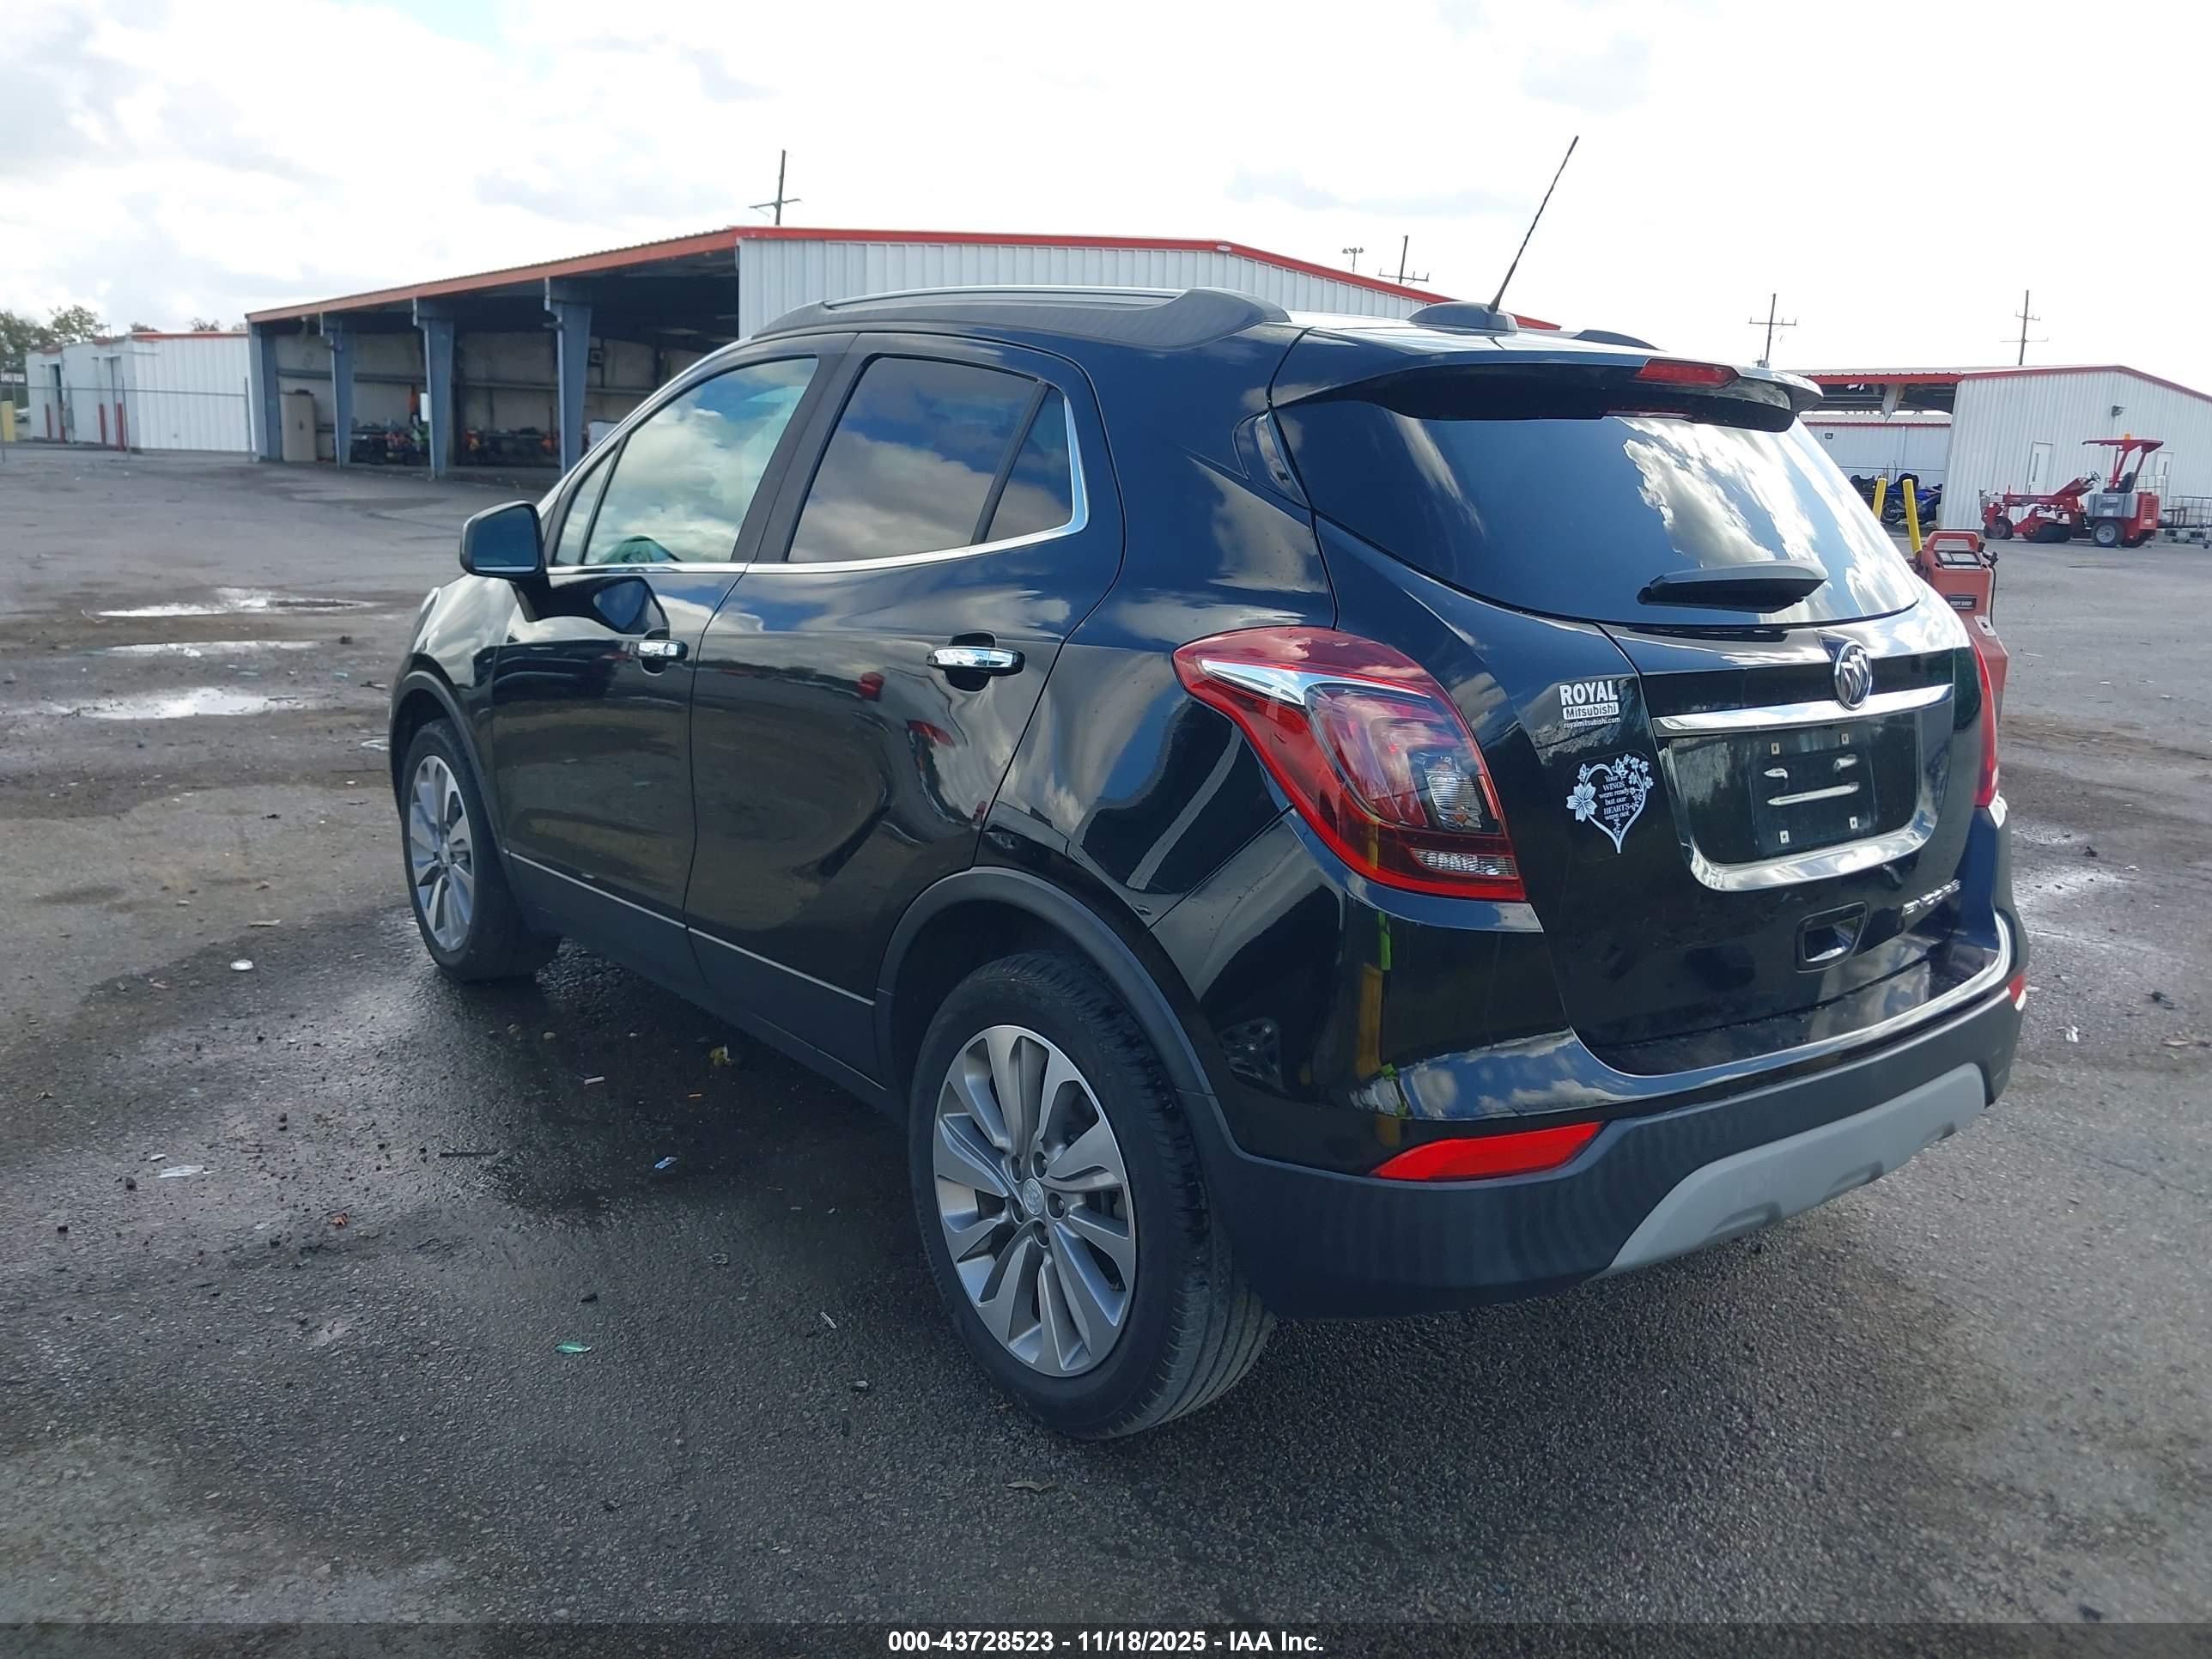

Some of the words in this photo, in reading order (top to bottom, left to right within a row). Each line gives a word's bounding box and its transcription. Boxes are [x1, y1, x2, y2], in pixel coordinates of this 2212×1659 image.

[1559, 679, 1618, 706] ROYAL
[1565, 702, 1618, 719] Mitsubishi
[1564, 716, 1621, 730] royalmitsubishi.com
[1602, 781, 1625, 792] WINGS
[1603, 802, 1630, 815] HEARTS
